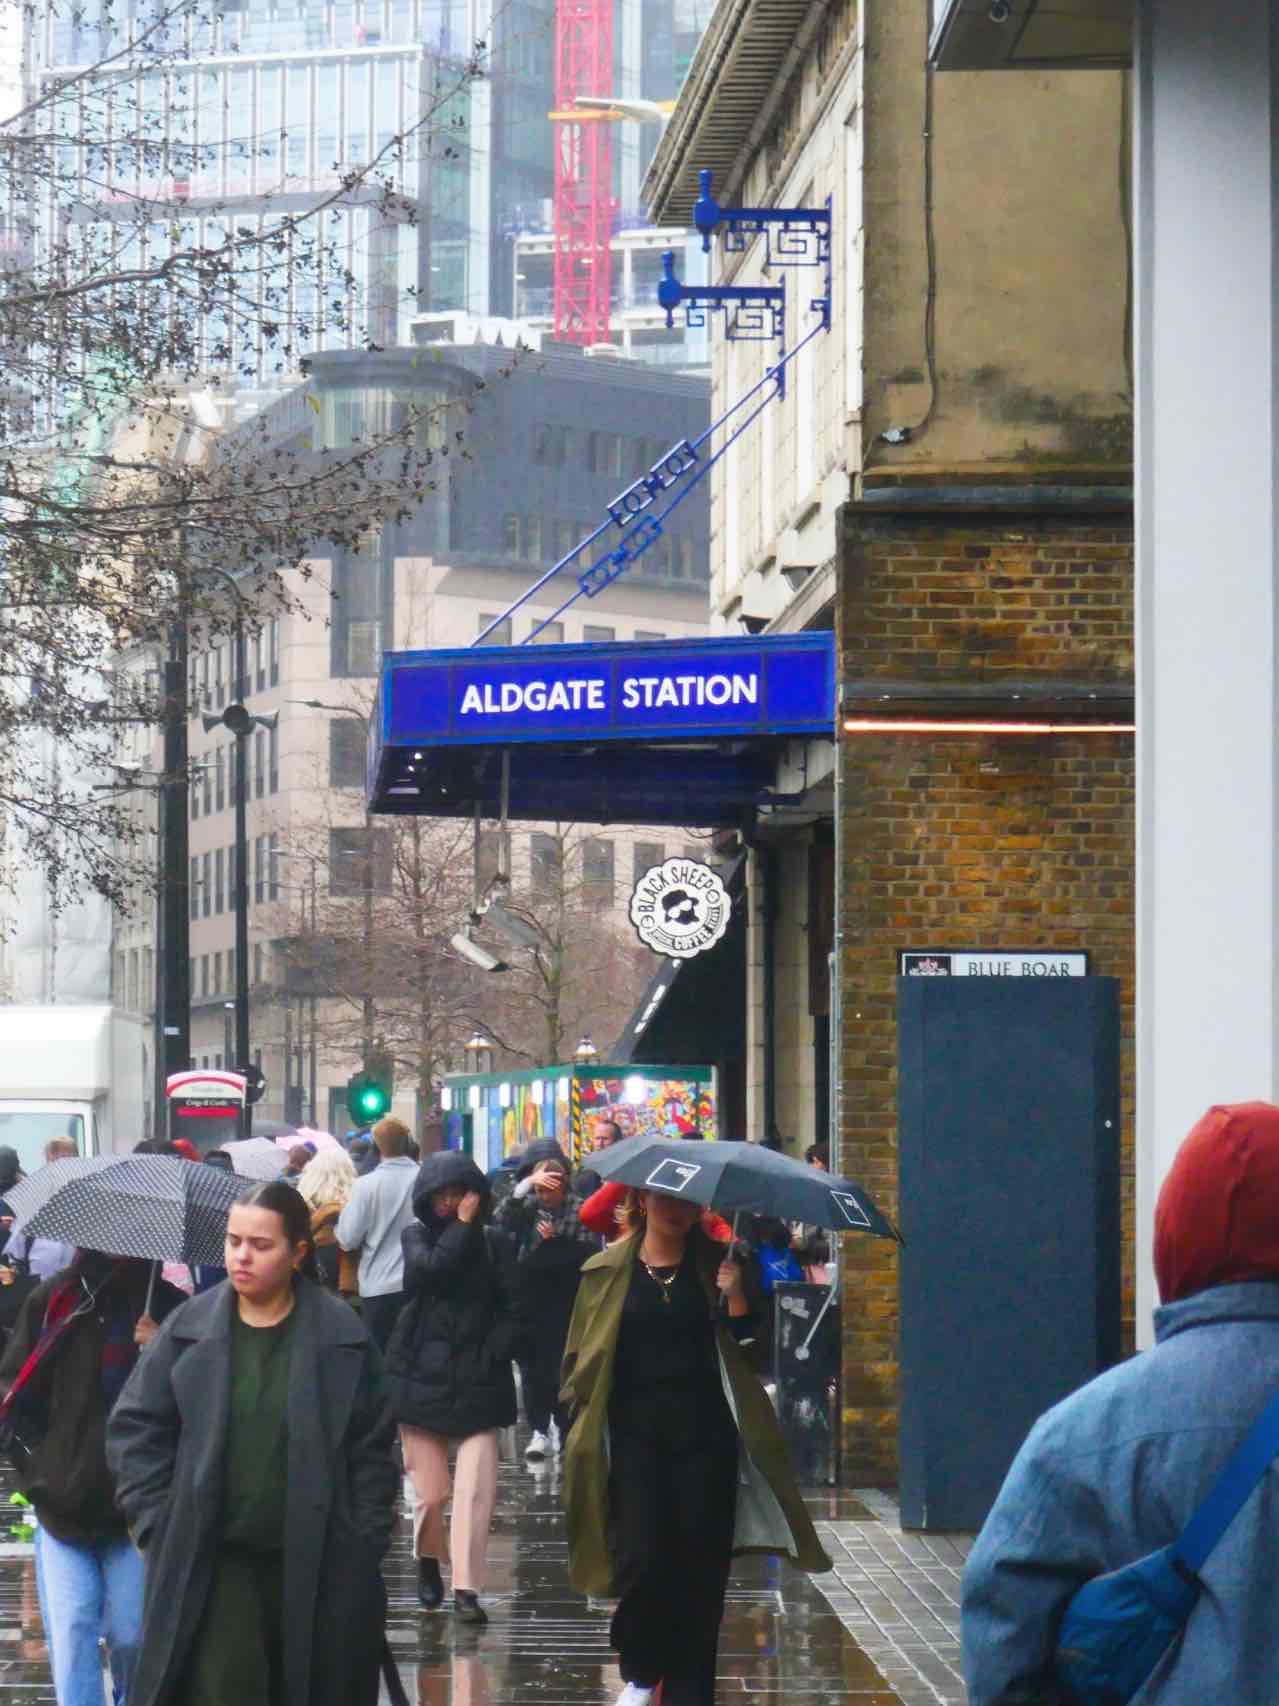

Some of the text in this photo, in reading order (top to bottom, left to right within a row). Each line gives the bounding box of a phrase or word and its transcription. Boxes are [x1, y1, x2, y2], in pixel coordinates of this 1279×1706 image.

[460, 674, 758, 714] ALDGATE STATION
[638, 866, 714, 913] BLACK SHEEP
[968, 961, 1071, 976] BLUE BOAR
